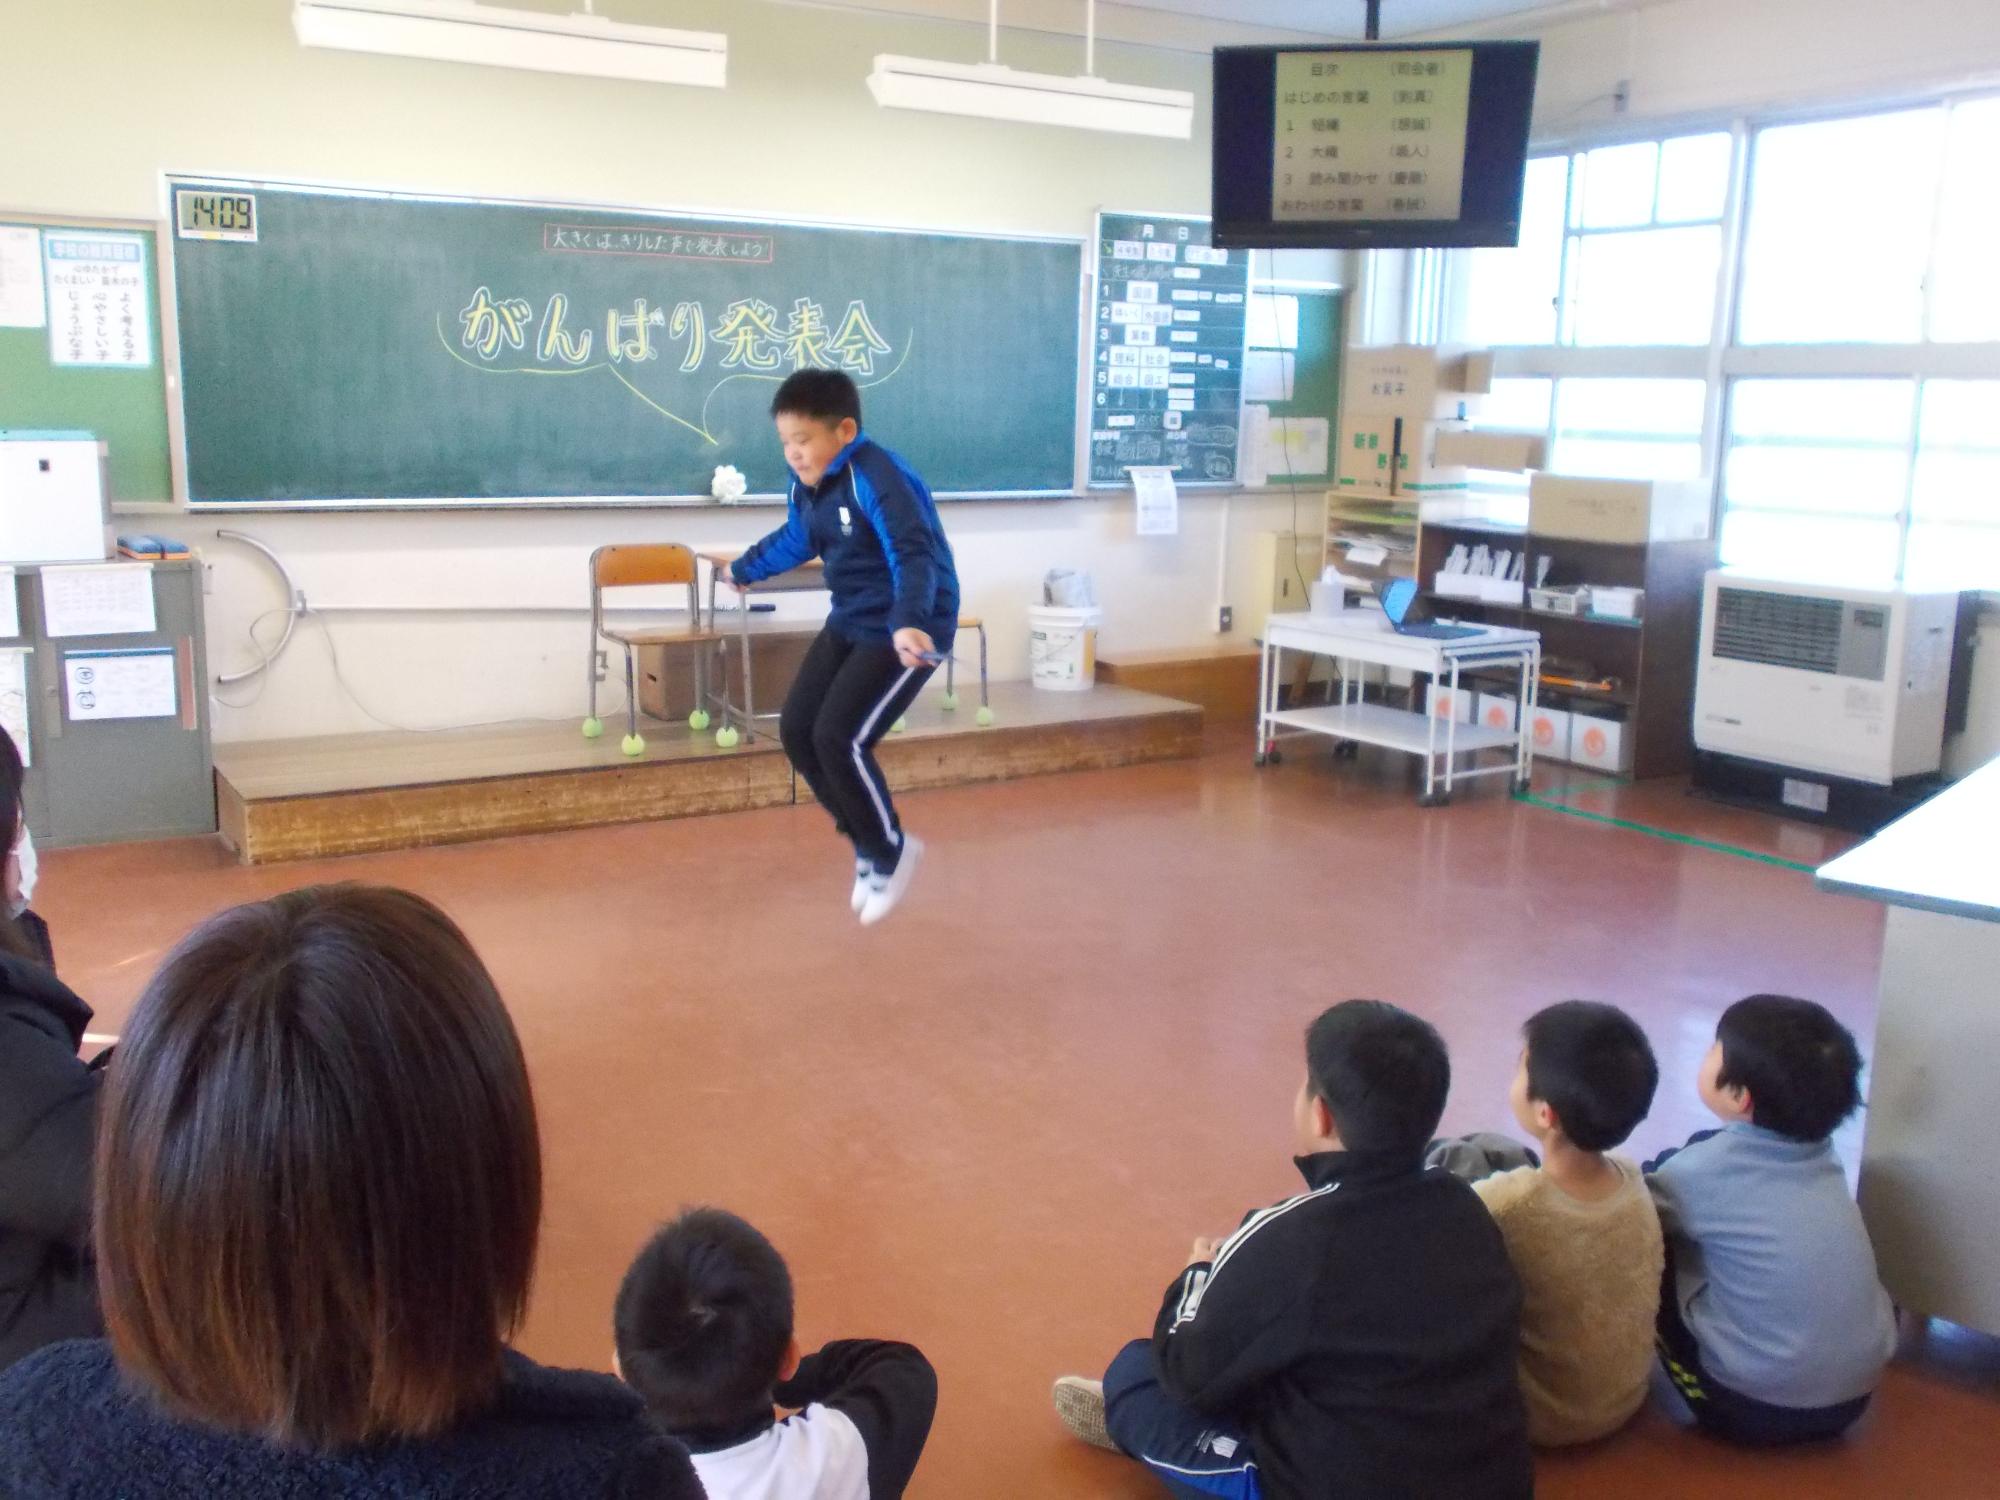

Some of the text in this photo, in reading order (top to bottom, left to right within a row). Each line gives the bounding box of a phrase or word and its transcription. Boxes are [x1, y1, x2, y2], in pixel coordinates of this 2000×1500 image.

[1311, 62, 1339, 76] 目次
[1284, 90, 1369, 104] はじめの言葉
[1286, 119, 1295, 131] 1
[1285, 146, 1294, 159] 2
[1284, 173, 1293, 185] 3
[1281, 199, 1364, 212] おわりの言葉
[1143, 224, 1188, 240] 月 日
[1103, 285, 1110, 297] 1
[1101, 306, 1110, 319] 2
[460, 286, 892, 374] がんばり発表会
[1099, 328, 1109, 340] 3
[1098, 350, 1107, 362] 4
[1098, 371, 1107, 384] 5
[1096, 392, 1106, 405] 6
